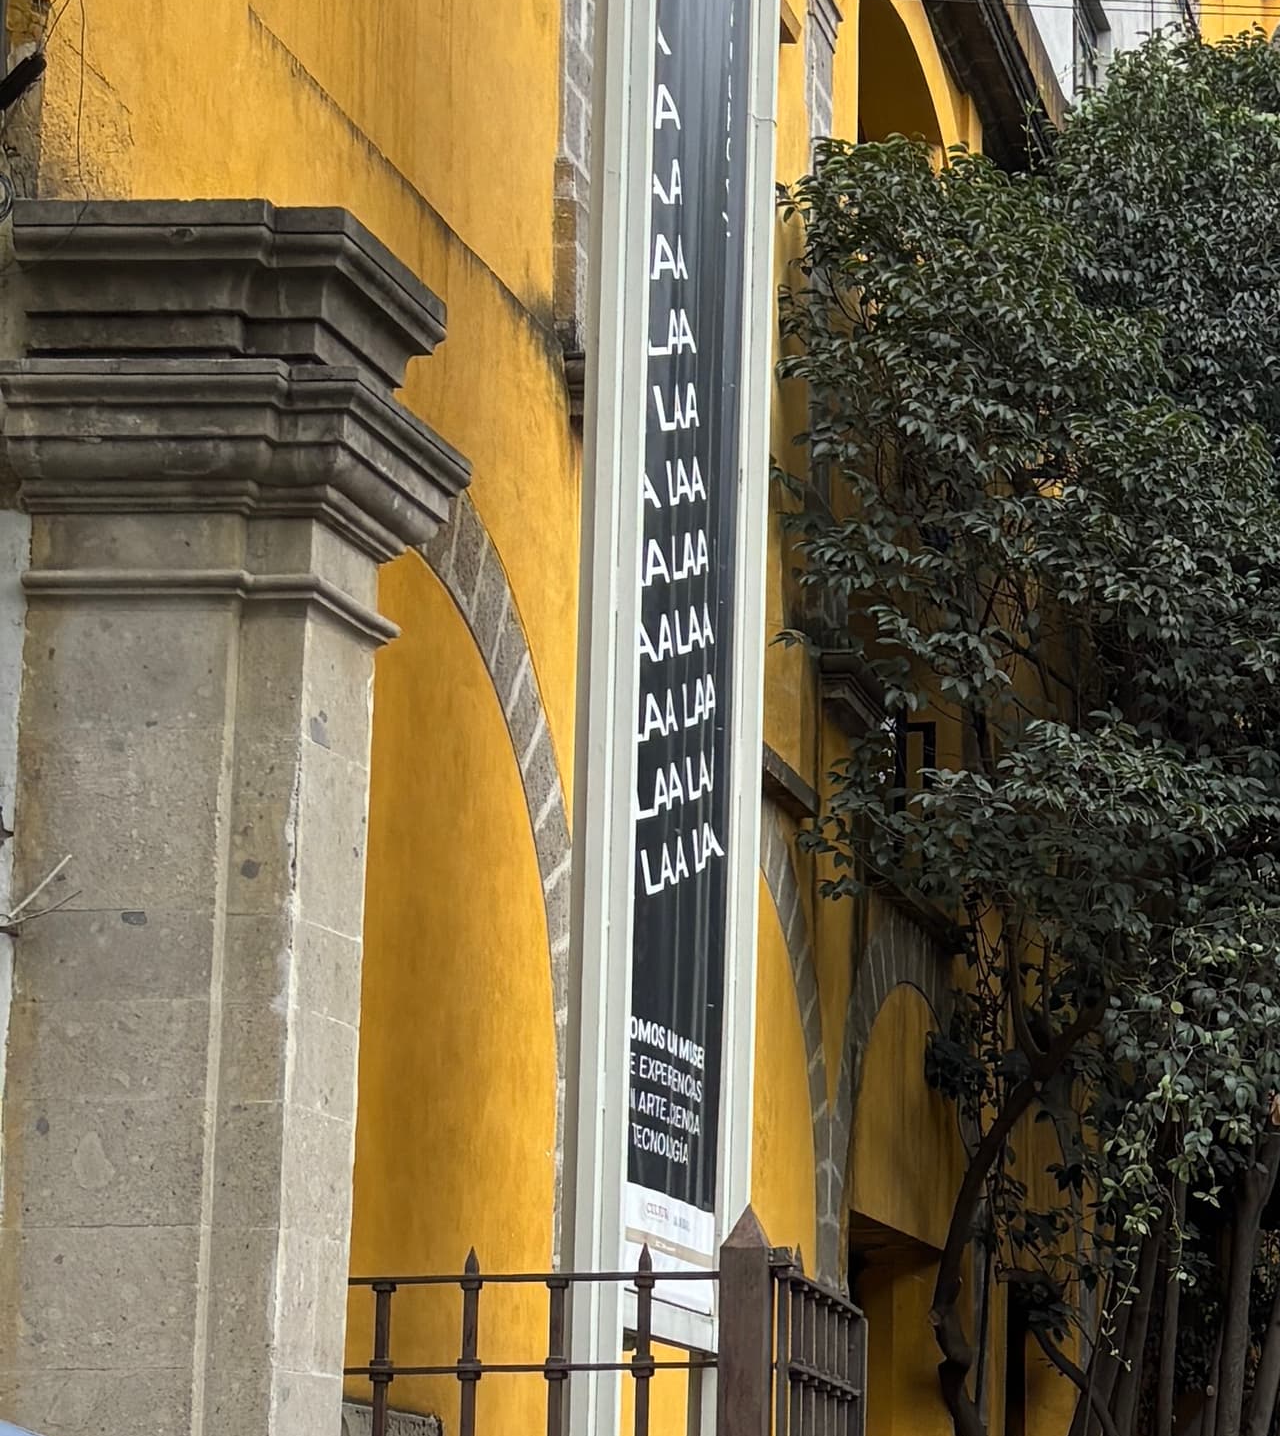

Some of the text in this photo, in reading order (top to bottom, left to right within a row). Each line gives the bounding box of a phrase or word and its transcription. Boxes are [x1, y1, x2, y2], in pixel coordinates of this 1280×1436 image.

[653, 382, 700, 432] LAA
[666, 456, 707, 506] LAA
[672, 529, 709, 581] LAA
[674, 602, 715, 655] LAA
[682, 673, 716, 728] LAA
[640, 835, 690, 896] LAA
[630, 1016, 665, 1050] OMOS
